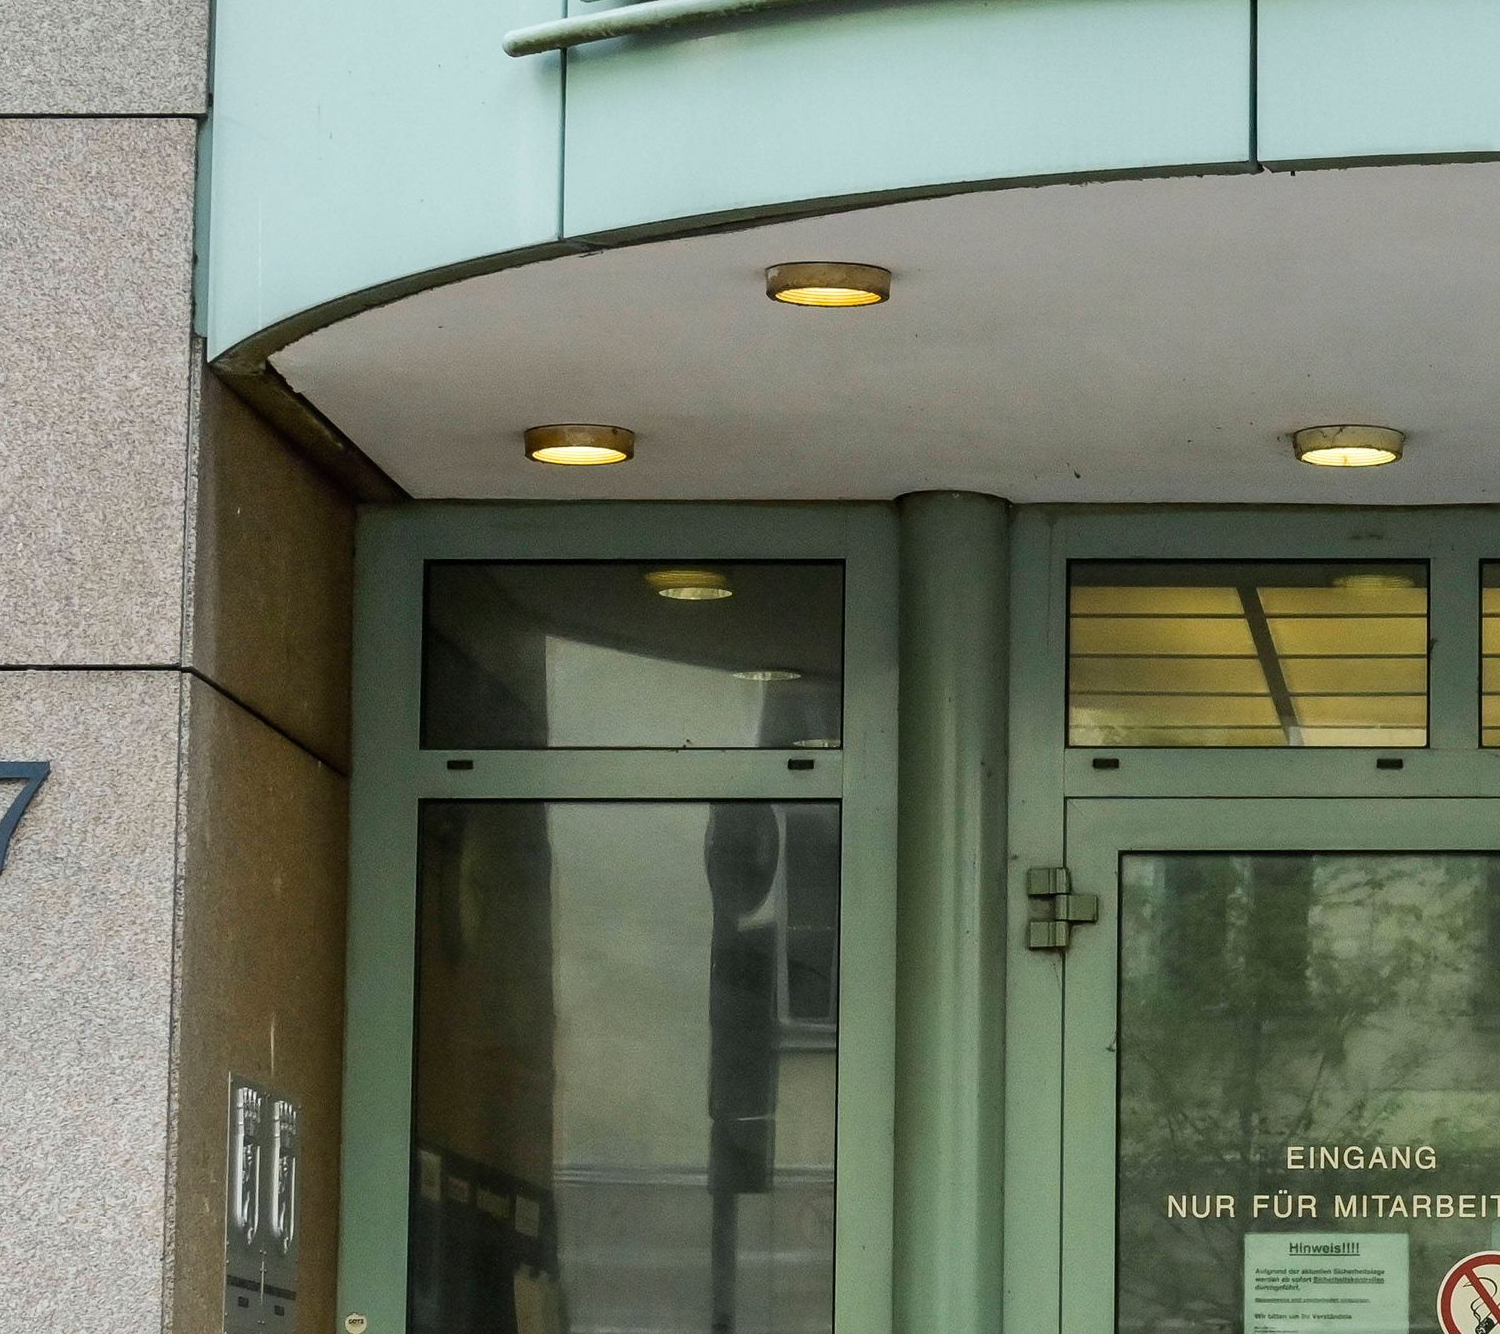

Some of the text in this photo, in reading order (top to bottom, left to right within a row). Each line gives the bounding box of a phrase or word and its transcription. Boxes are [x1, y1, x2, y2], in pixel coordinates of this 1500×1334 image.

[1286, 1145, 1437, 1170] EINGANG
[1168, 1195, 1235, 1218] NUR
[1253, 1190, 1317, 1218] FÜR
[1288, 1242, 1360, 1254] Hinweis!!!!
